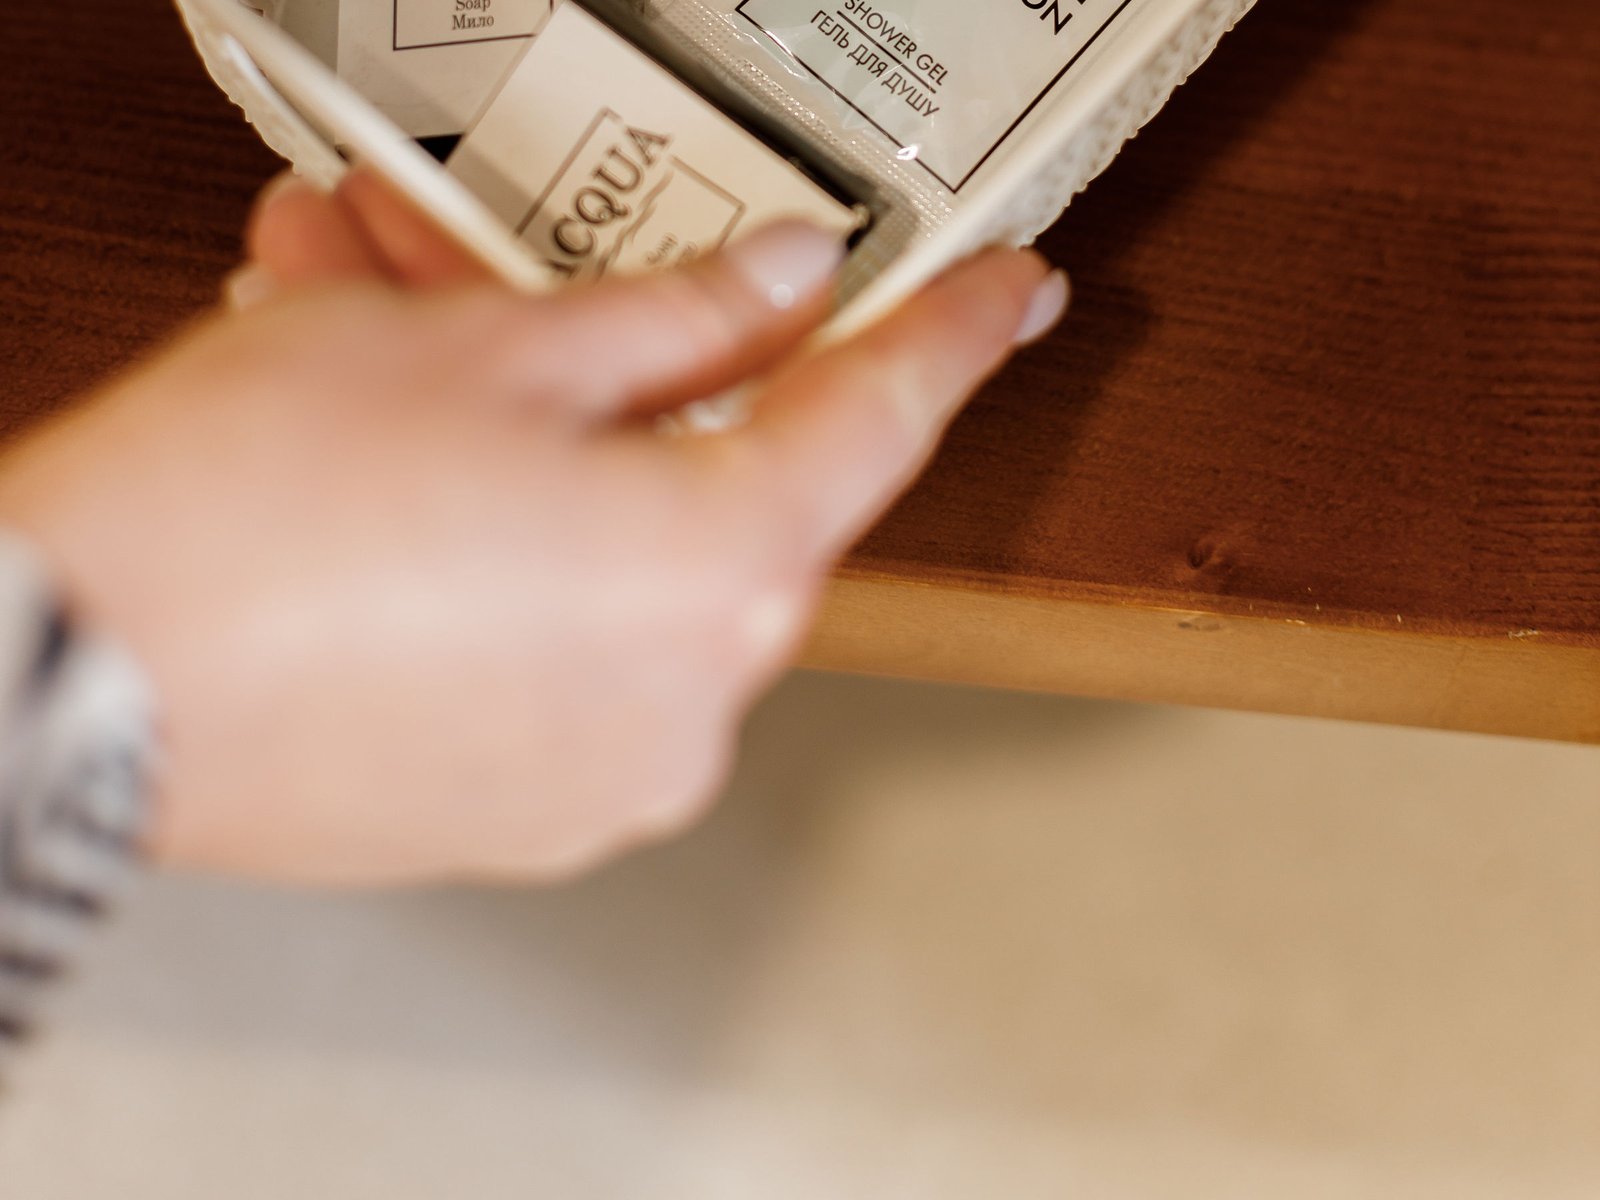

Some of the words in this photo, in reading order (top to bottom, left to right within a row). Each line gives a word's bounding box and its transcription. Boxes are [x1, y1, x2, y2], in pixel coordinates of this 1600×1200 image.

[452, 14, 495, 30] Мило
[810, 10, 849, 49] ГЕЛЬ
[846, 43, 888, 78] ДЛЯ
[881, 72, 940, 117] ДУШУ
[916, 54, 948, 86] GEL
